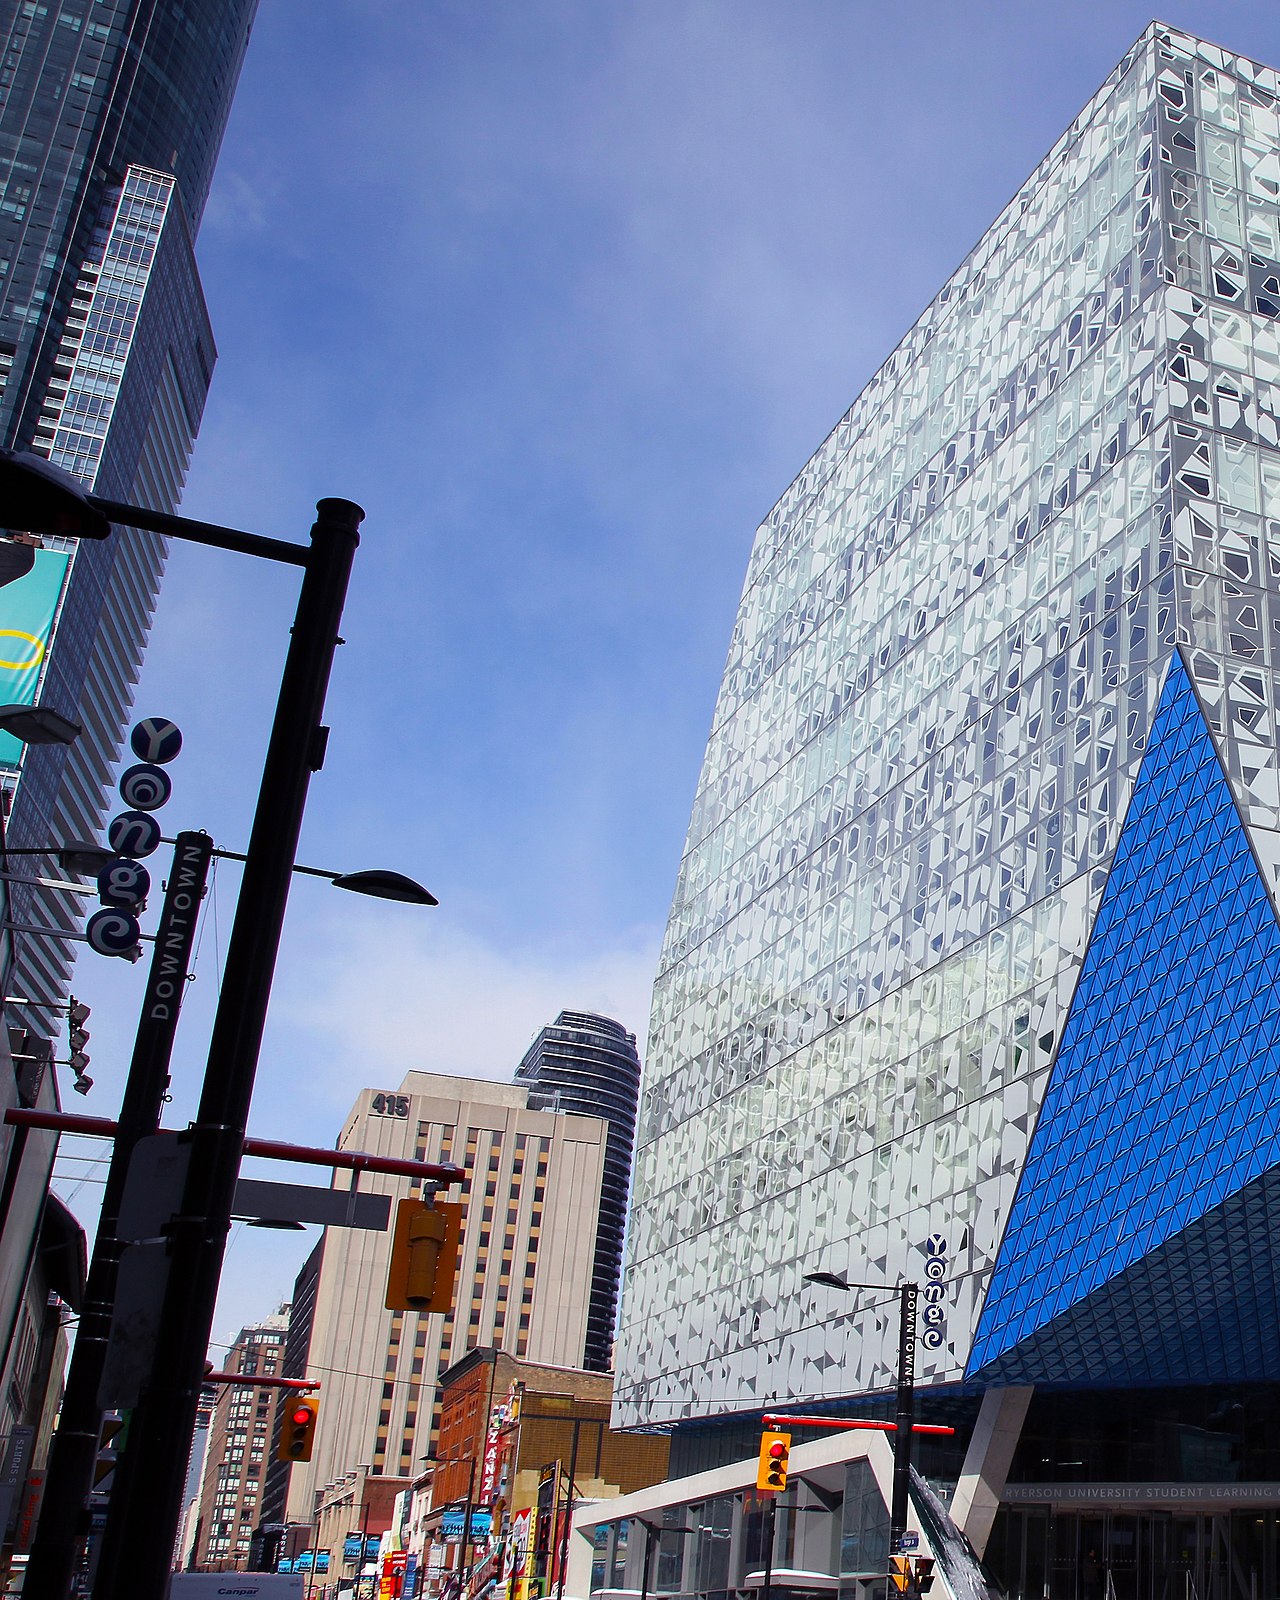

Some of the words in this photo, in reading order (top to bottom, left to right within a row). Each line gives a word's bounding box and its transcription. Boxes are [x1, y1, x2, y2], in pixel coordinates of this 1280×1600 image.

[89, 718, 180, 955] Yonge
[151, 845, 201, 1020] DOWNTOWN
[372, 1093, 409, 1117] 415
[924, 1233, 946, 1350] Yonge
[905, 1290, 916, 1376] DOWNTOWN
[10, 1439, 25, 1475] SPORTS
[1005, 1488, 1063, 1499] RYERSON
[1068, 1487, 1141, 1499] UNIVERSITY
[1146, 1487, 1203, 1498] STUDENT
[1209, 1486, 1273, 1498] LEARNING
[217, 1587, 258, 1597] Canpar
